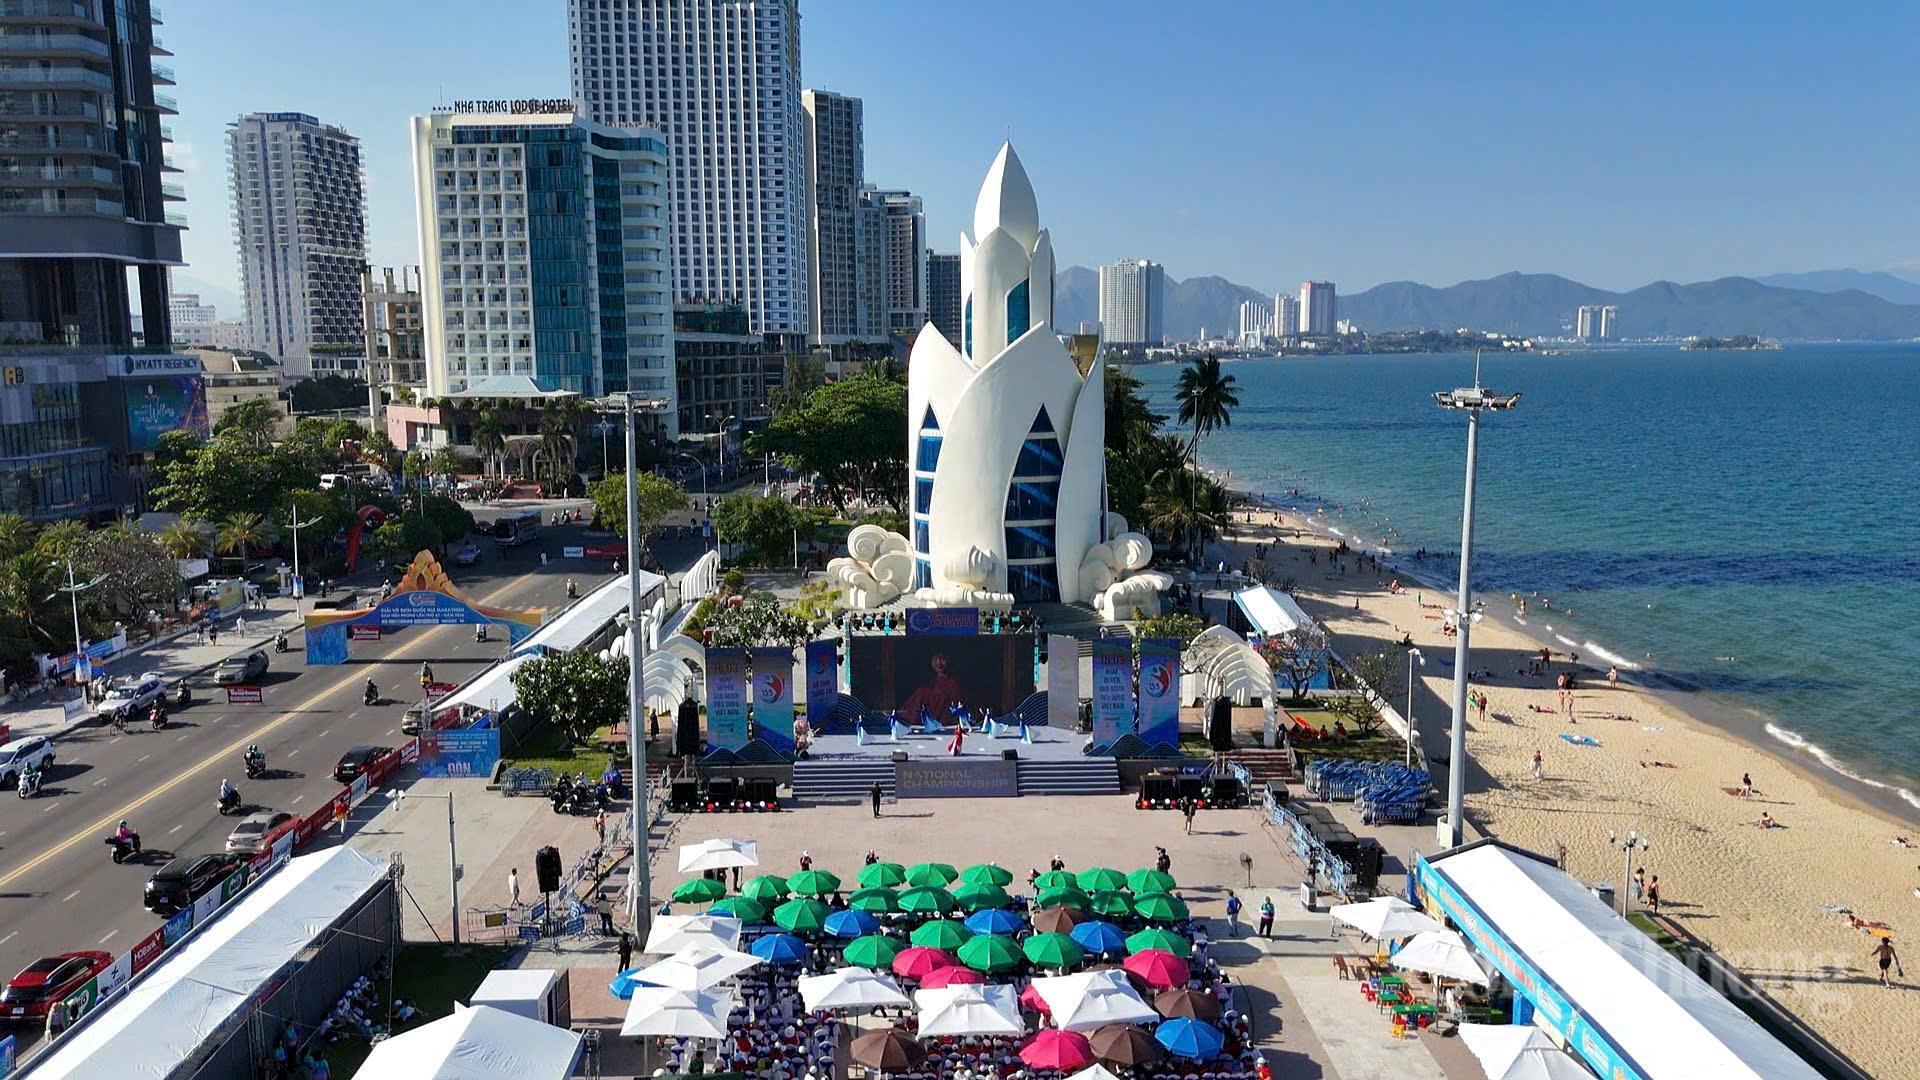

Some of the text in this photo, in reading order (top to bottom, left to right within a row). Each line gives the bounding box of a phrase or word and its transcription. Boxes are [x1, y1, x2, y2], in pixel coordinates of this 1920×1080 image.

[454, 100, 474, 113] NHA
[476, 100, 508, 113] TRANG
[510, 99, 540, 113] LODGE
[135, 357, 199, 370] HYATT REGENCY
[902, 770, 971, 780] NATIONAL
[902, 780, 1010, 790] CHAMPIONSHIP
[133, 939, 158, 963] HDBank
